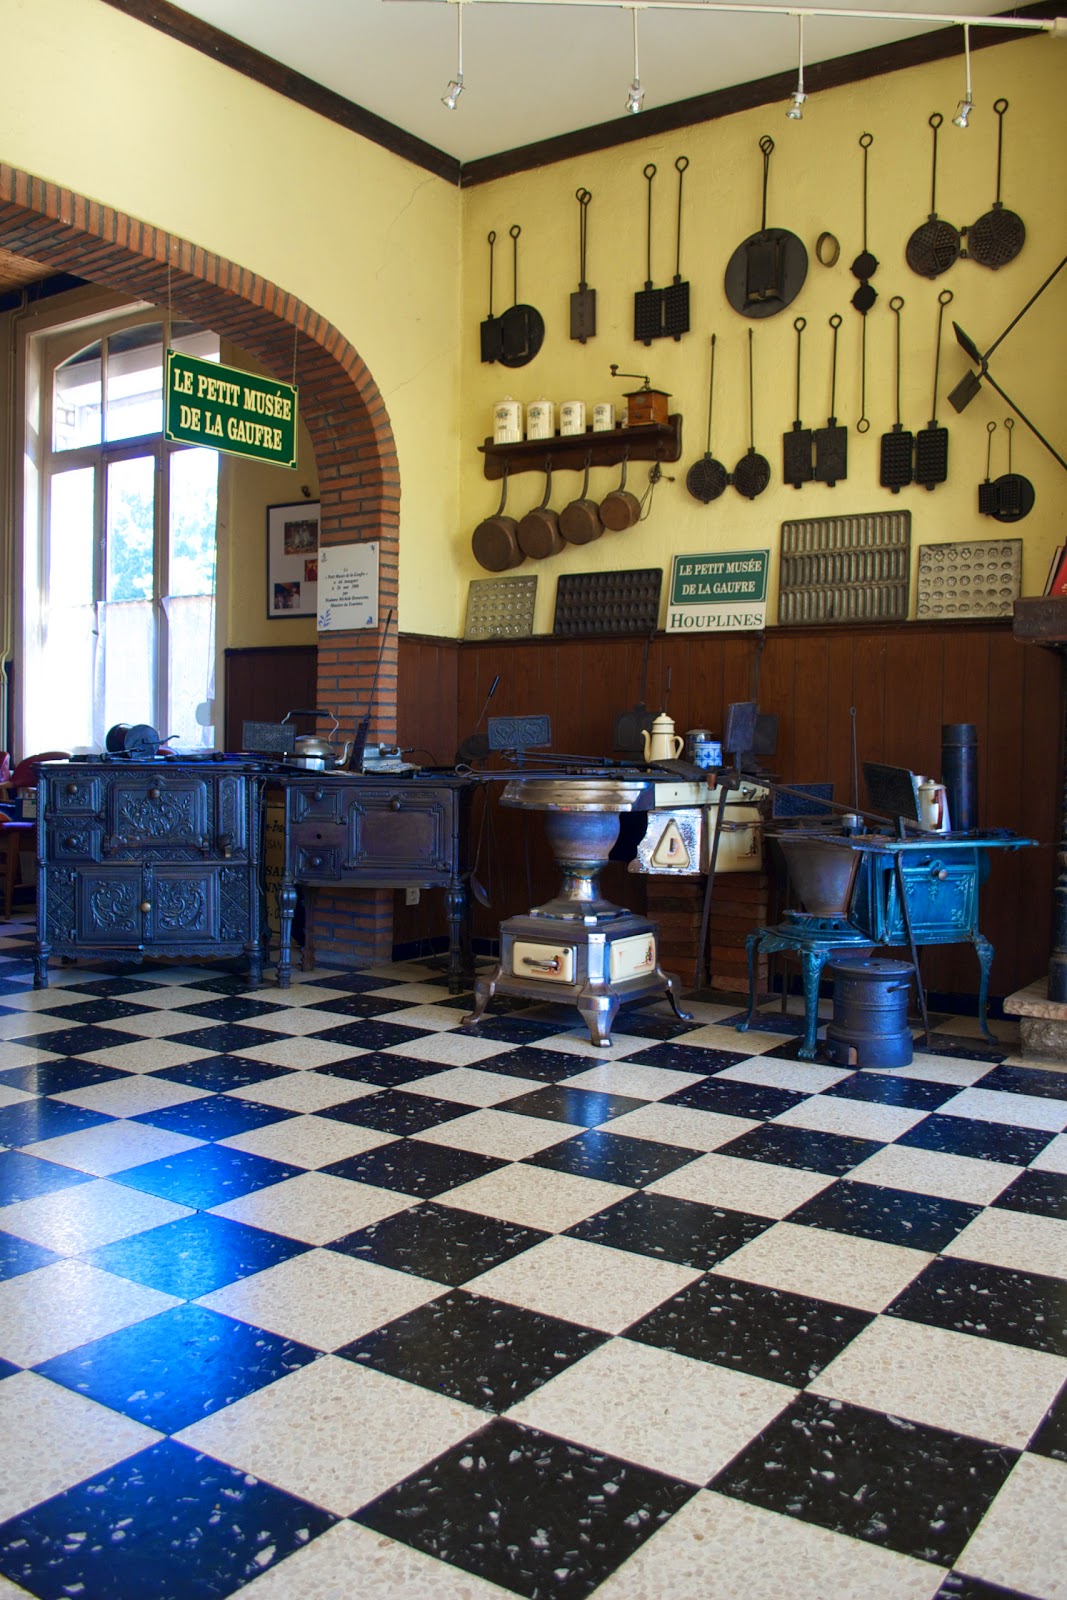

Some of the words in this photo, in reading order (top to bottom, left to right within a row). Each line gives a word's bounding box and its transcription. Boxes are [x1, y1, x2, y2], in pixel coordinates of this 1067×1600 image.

[174, 368, 194, 395] LE
[197, 374, 240, 407] PETIT
[244, 388, 292, 421] MUSÉE
[180, 404, 201, 432] DE
[204, 411, 224, 438] LA
[227, 417, 282, 451] GAUFRE
[679, 564, 692, 576] LE
[694, 562, 725, 575] PETIT
[726, 558, 762, 574] MUSÉE
[682, 584, 696, 595] DE
[698, 583, 711, 594] LA
[713, 581, 756, 593] GAUFRE
[670, 613, 762, 628] HOUPLINES
